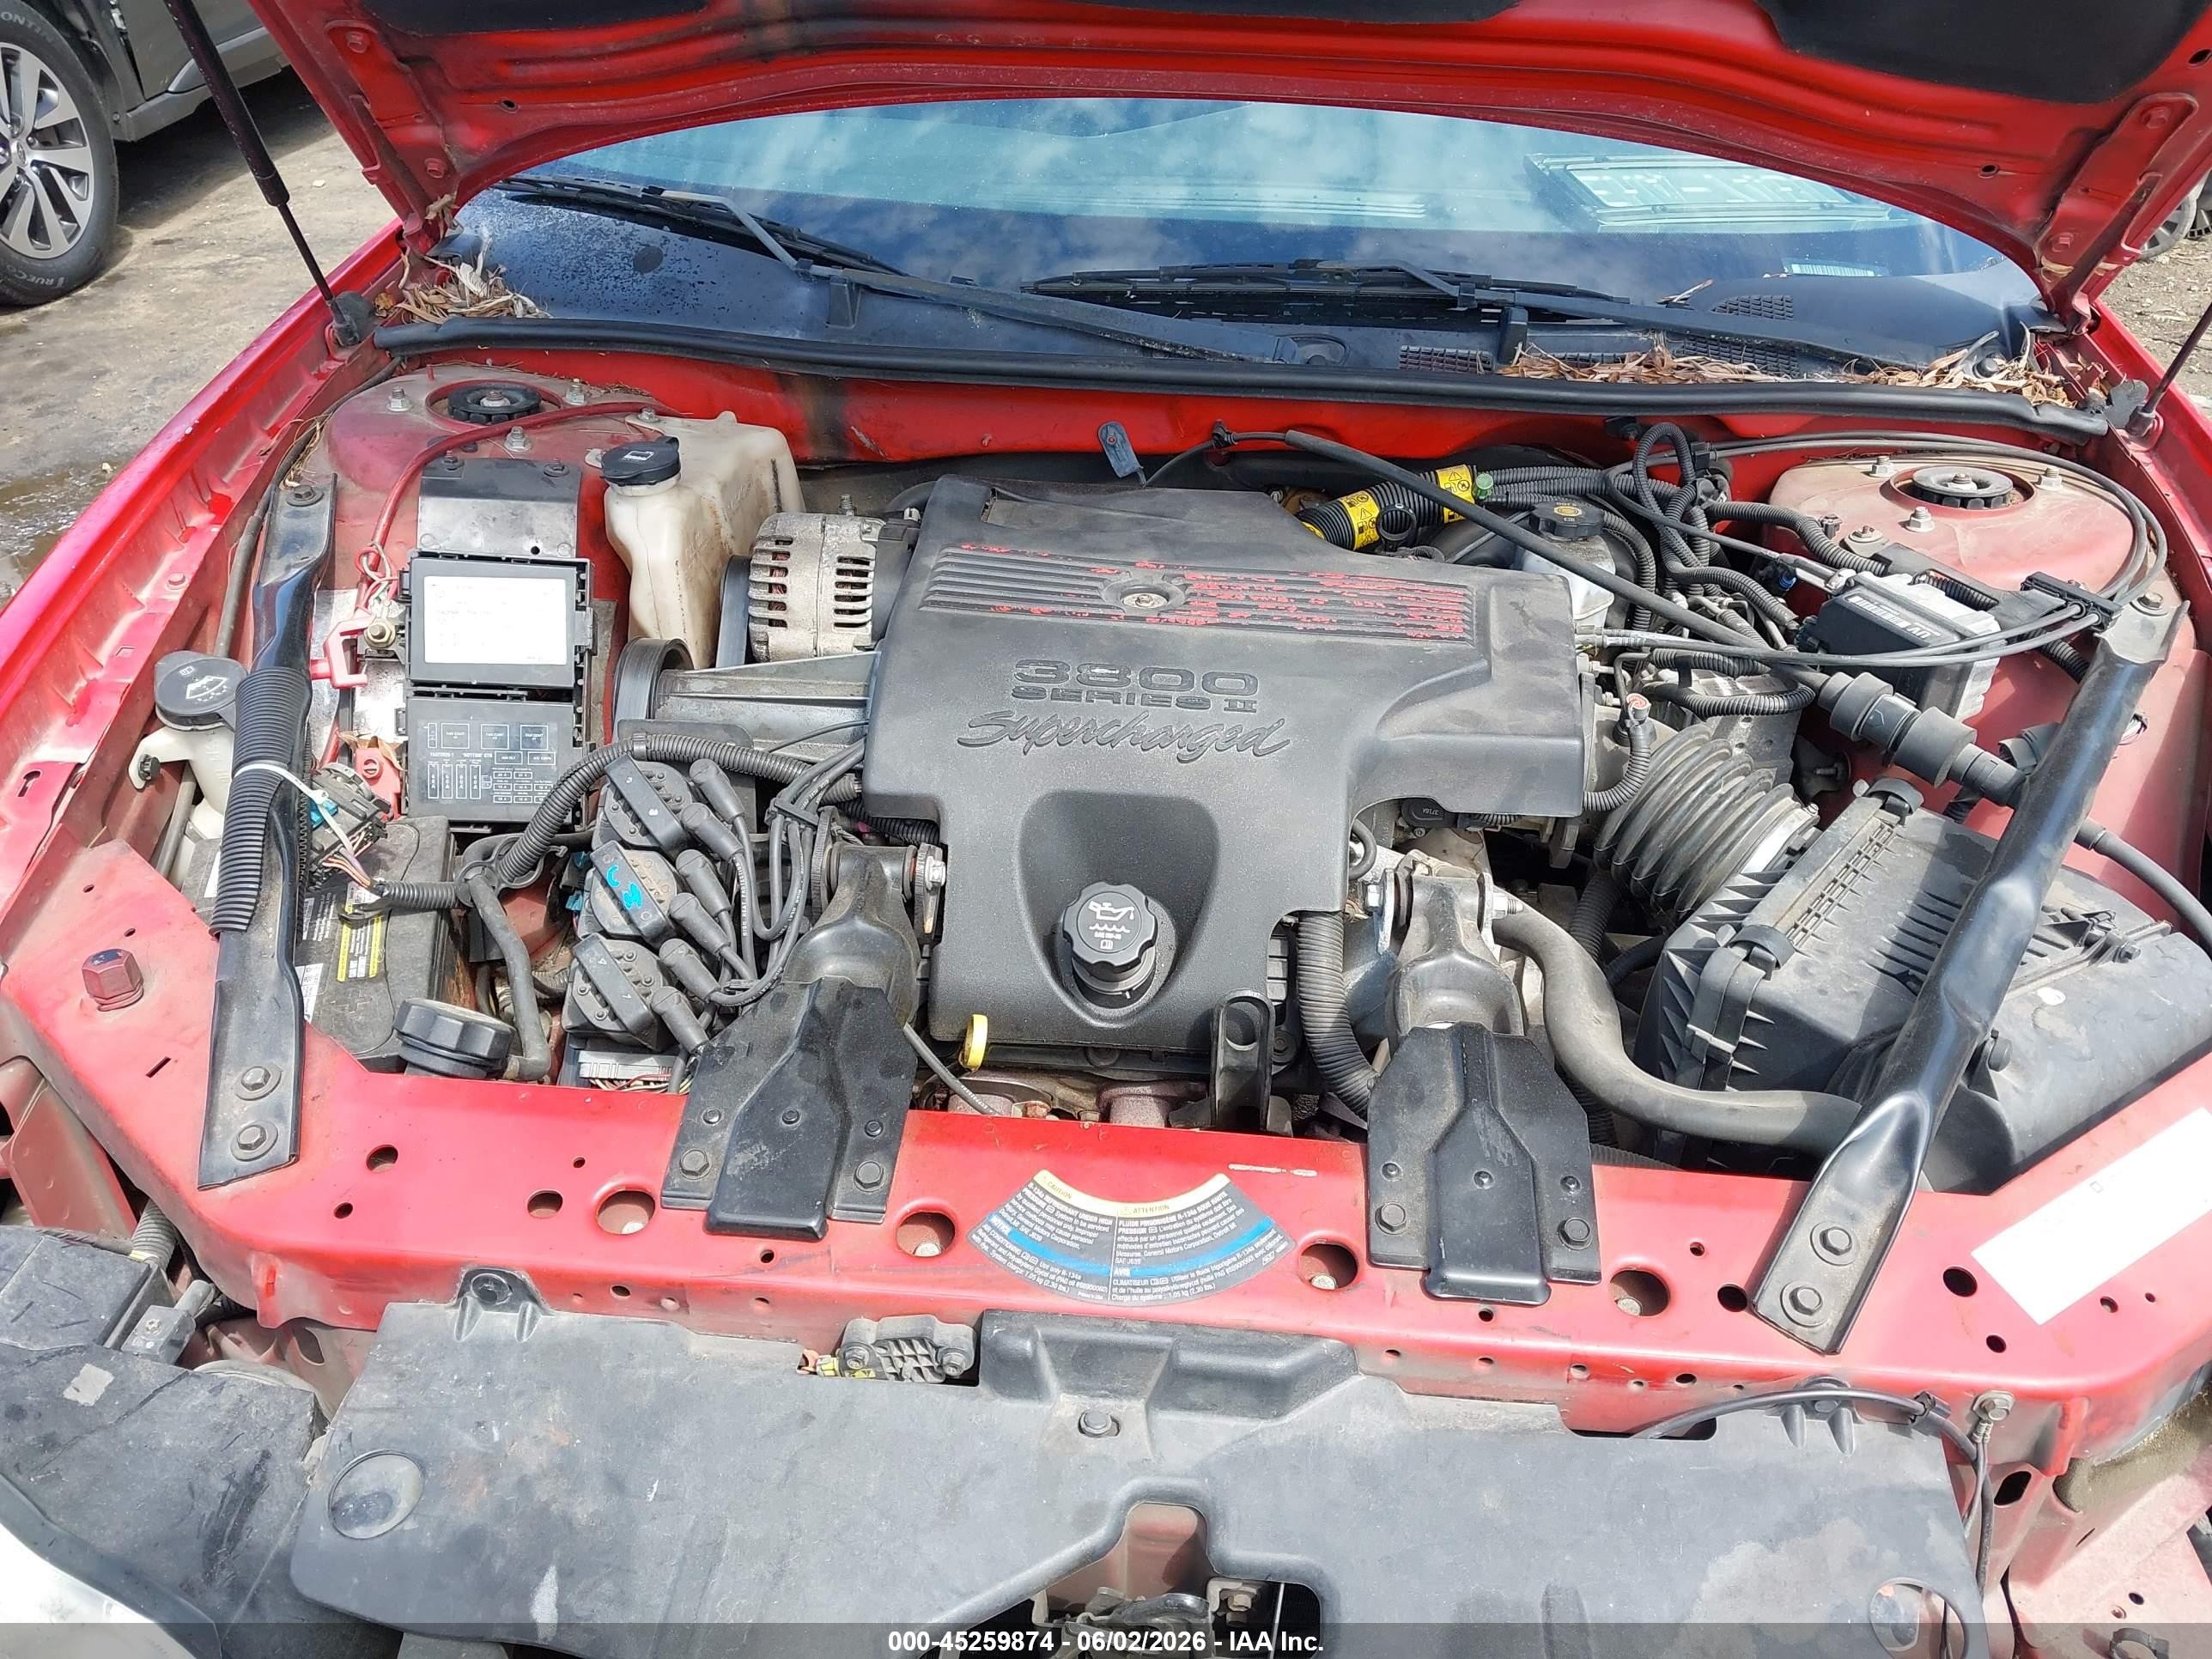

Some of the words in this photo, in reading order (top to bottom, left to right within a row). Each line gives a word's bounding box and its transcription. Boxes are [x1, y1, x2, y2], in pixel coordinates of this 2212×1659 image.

[1014, 659, 1258, 696] 3800
[1012, 686, 1211, 709] SERIES
[1224, 698, 1258, 714] II
[957, 709, 1290, 763] Supercharged
[1047, 1181, 1073, 1200] CAUTION
[1133, 1205, 1170, 1213] ATTENTION
